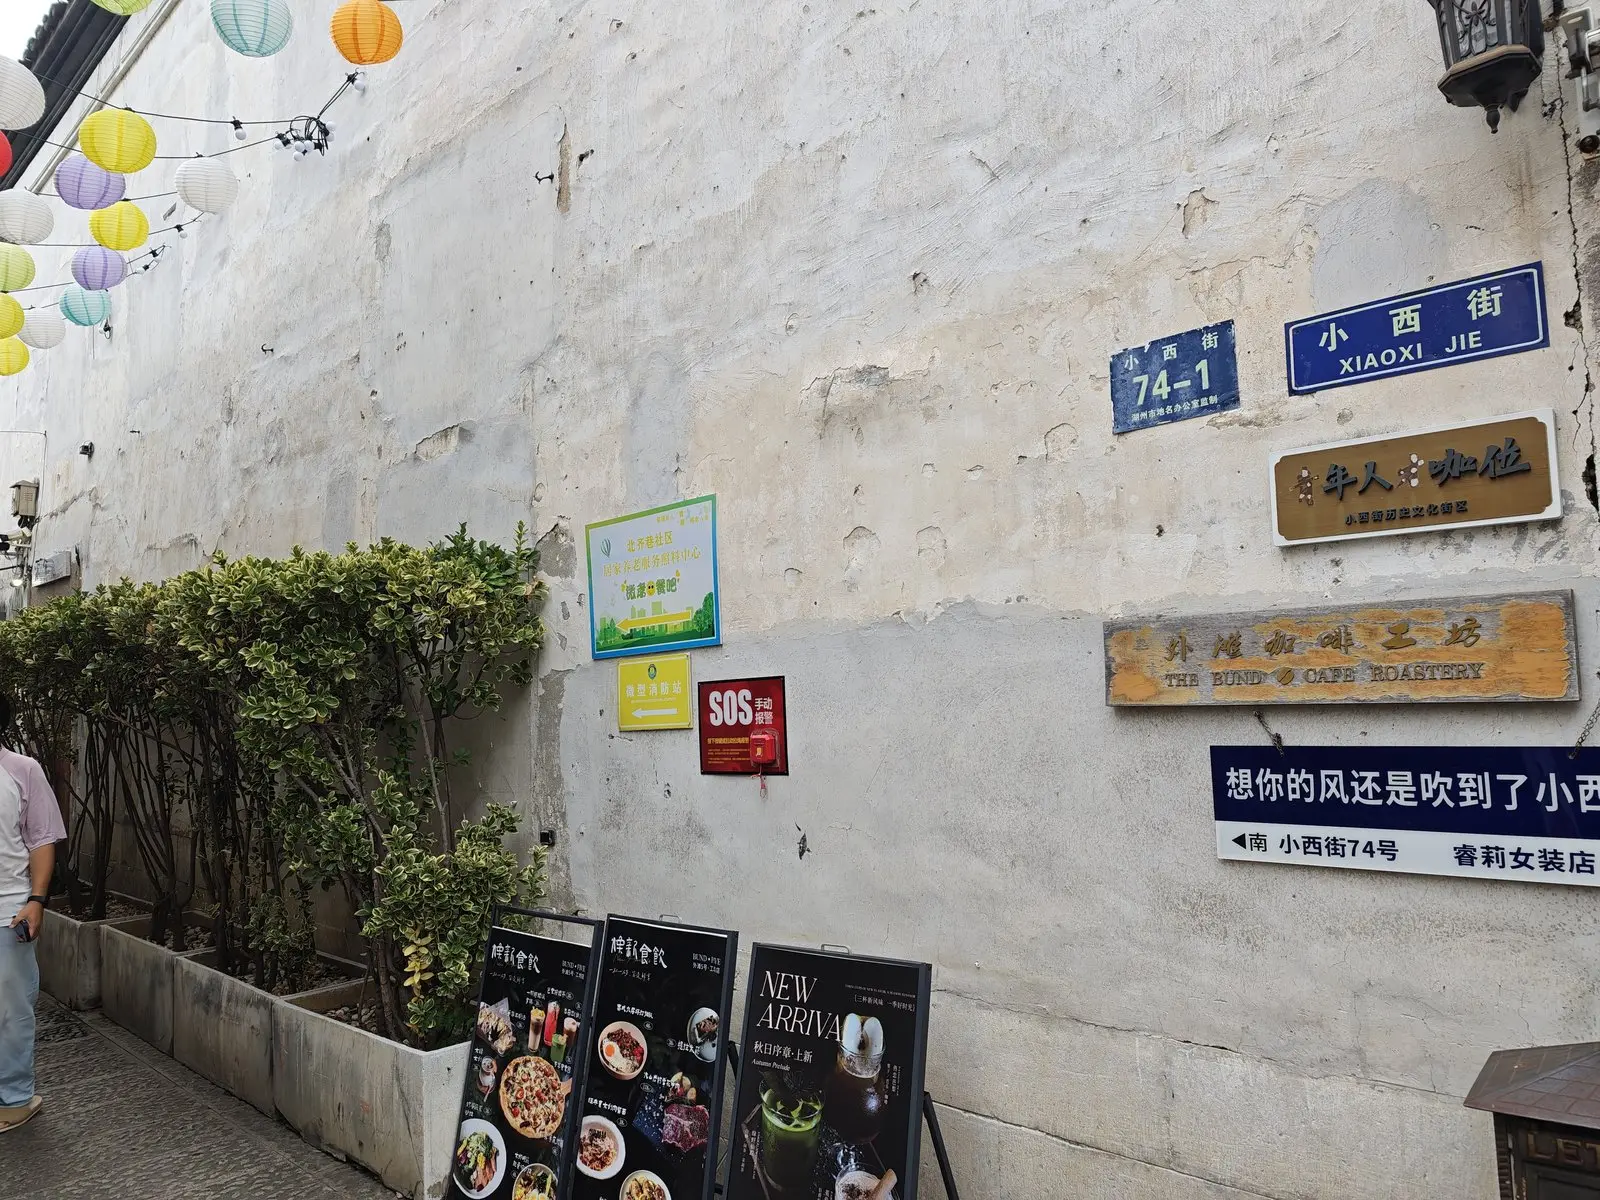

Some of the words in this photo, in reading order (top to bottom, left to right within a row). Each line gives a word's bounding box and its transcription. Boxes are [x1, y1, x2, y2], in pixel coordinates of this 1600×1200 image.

[1318, 286, 1504, 352] 小西街
[1124, 332, 1219, 370] 小西街
[1340, 342, 1424, 375] XIAOXI
[1444, 330, 1483, 353] JIE
[1132, 359, 1210, 406] 74-1
[1131, 395, 1218, 421] 湖州市地名办公室监制
[1428, 437, 1532, 487] 咖位
[1345, 500, 1469, 525] 小西街历史文化街区
[604, 546, 701, 577] 居家养老服务照料中心
[1165, 616, 1482, 662] 外滩咖啡工坊
[625, 680, 682, 697] 微型消防站
[1164, 672, 1199, 687] THE
[1211, 670, 1263, 686] BUND
[1303, 667, 1356, 684] CAFE
[1370, 662, 1486, 682] ROASTERY
[708, 688, 753, 727] SOS
[754, 697, 773, 710] 手动
[754, 711, 773, 725] 报警
[1226, 767, 1600, 813] 想你的风还是吹到了小西
[1249, 833, 1268, 852] 南
[1279, 834, 1399, 862] 小西街74号
[1453, 844, 1596, 875] 睿莉女装店
[759, 970, 818, 1003] NEW
[756, 1003, 843, 1042] ARRIVA
[751, 1059, 771, 1069] Autumn
[771, 1061, 791, 1072] Prelude
[753, 1040, 813, 1064] 秋日序章·上新
